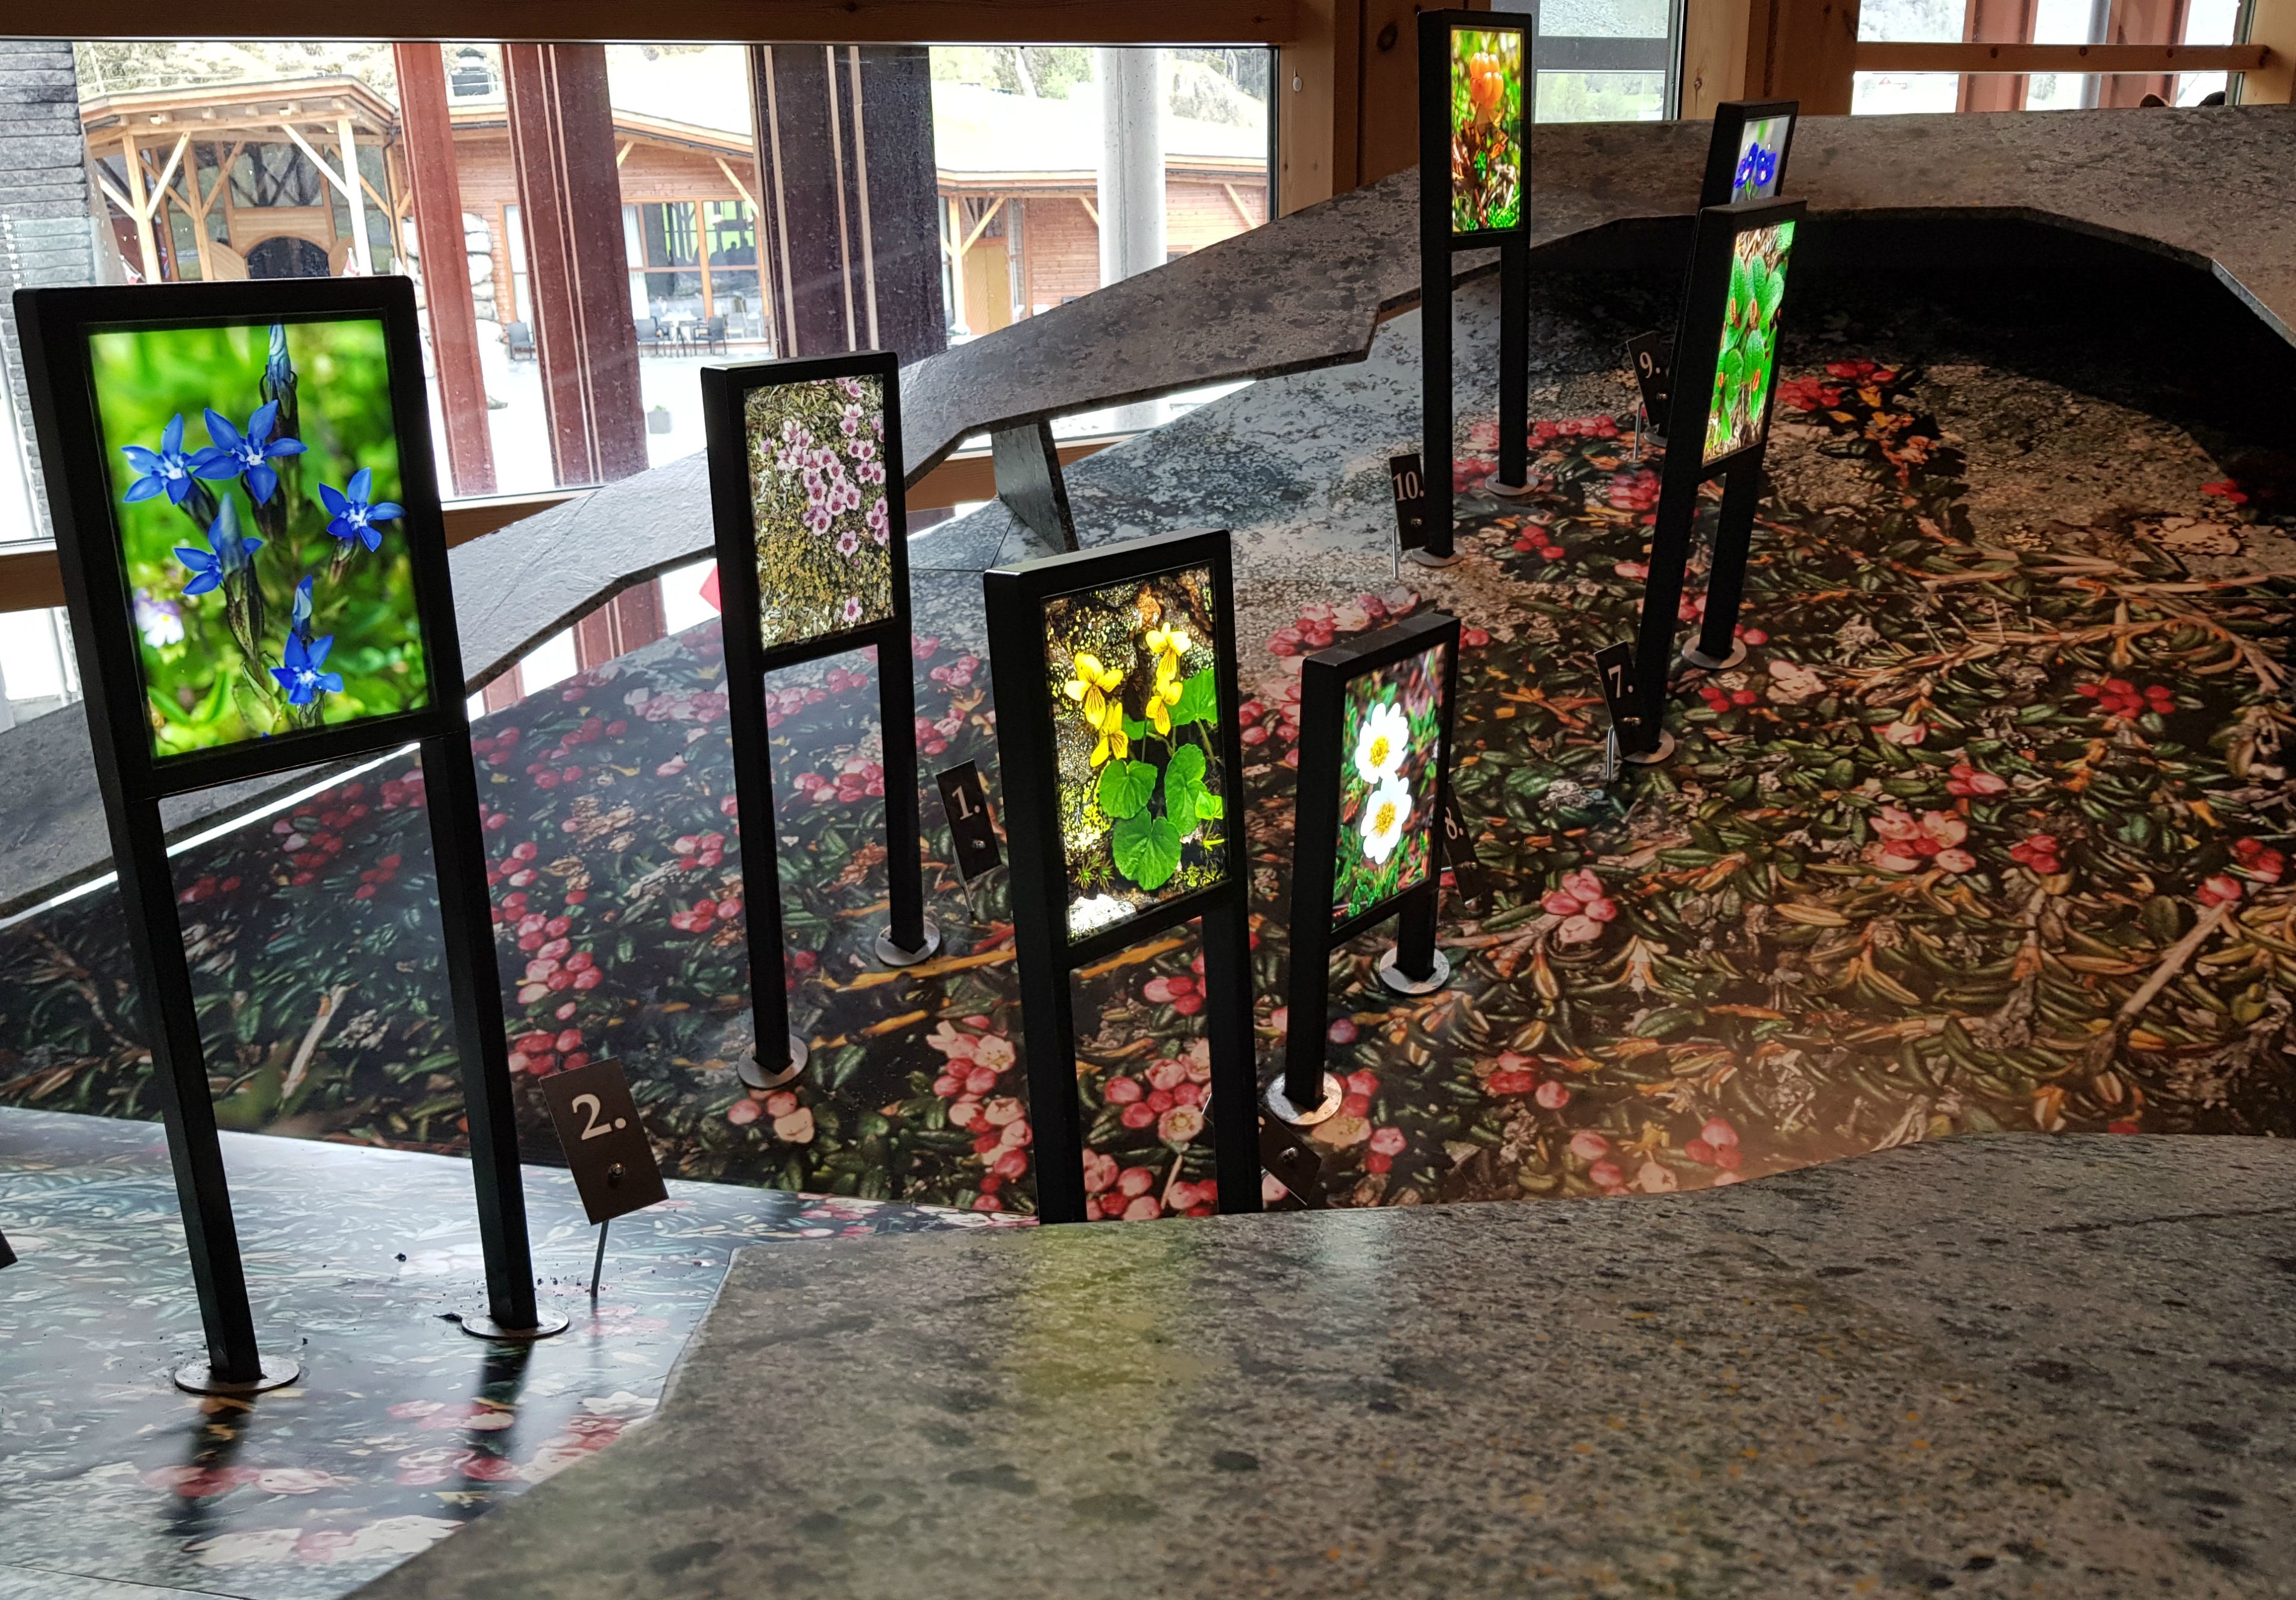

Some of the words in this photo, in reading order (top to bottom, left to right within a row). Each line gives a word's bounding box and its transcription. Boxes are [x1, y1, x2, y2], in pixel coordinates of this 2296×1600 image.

[1640, 351, 1660, 379] 9.
[1393, 471, 1425, 501] 10.
[1607, 664, 1633, 698] 7.
[952, 785, 980, 820] 1.
[572, 1093, 626, 1141] 2.
